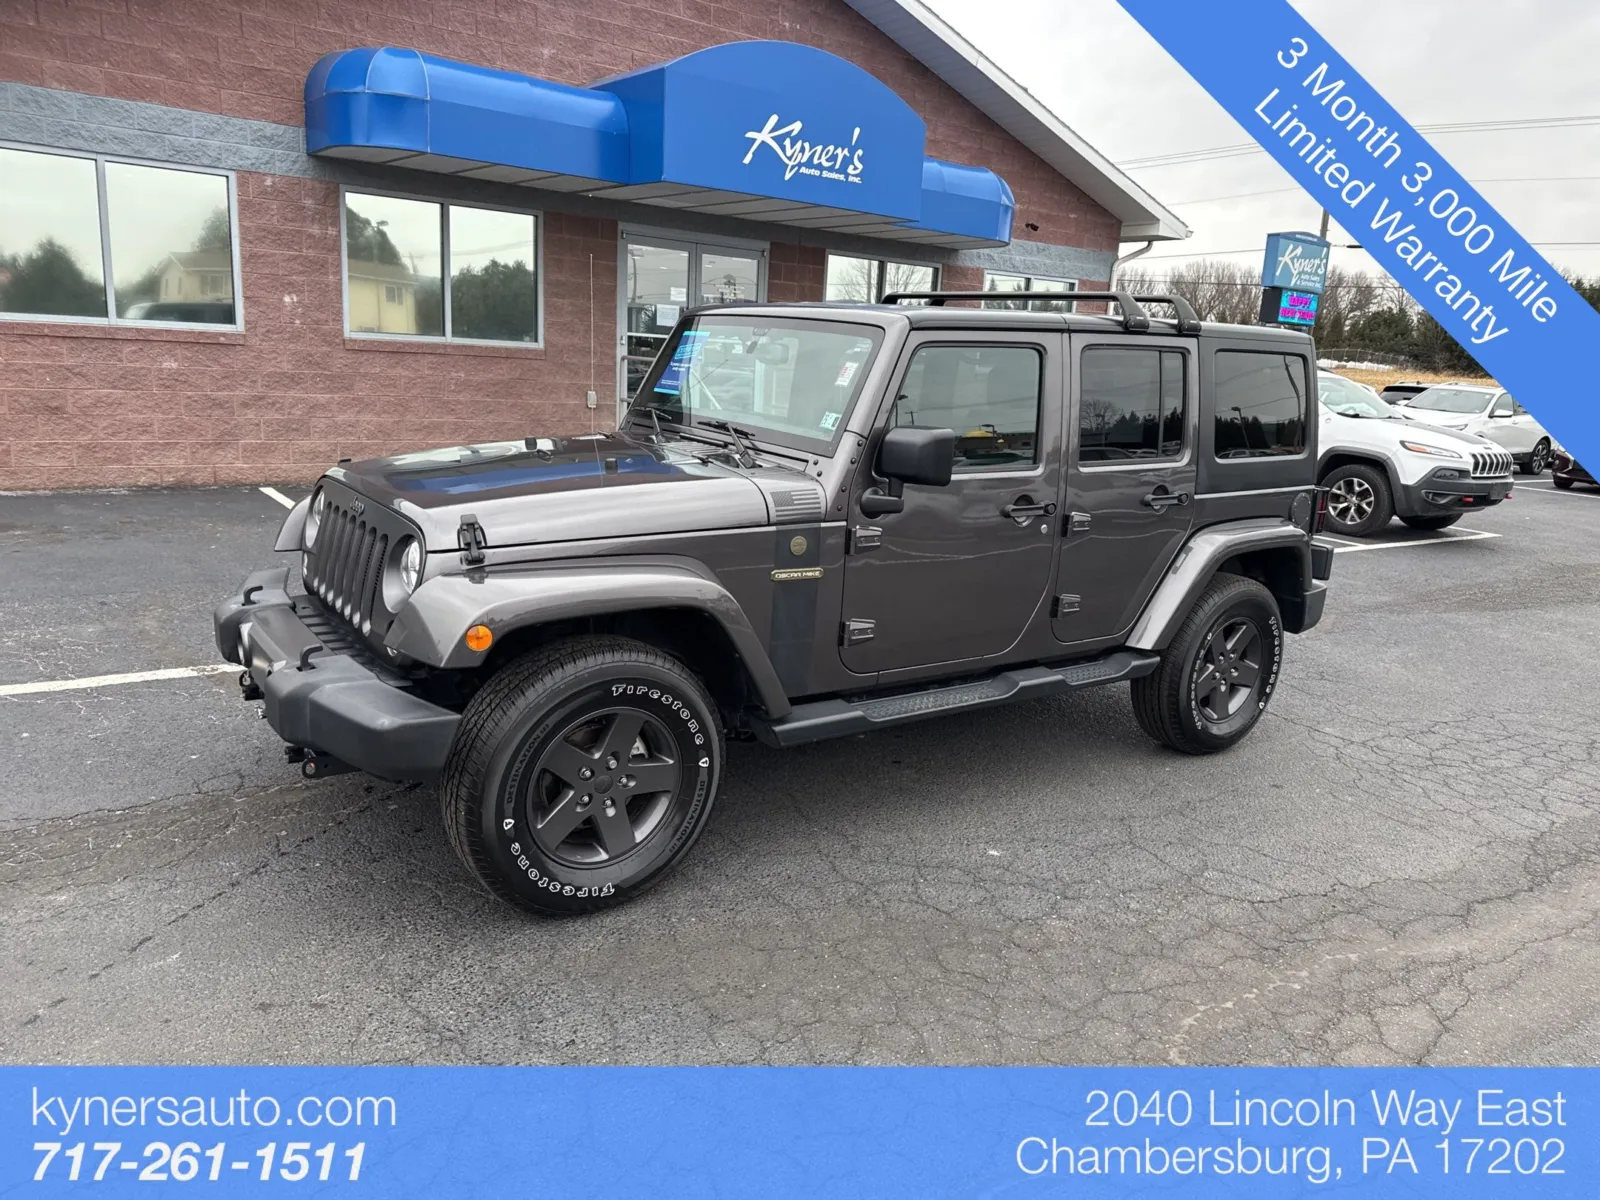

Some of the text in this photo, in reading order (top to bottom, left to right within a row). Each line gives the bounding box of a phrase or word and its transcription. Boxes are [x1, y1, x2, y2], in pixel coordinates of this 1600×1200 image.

[742, 113, 864, 181] Kyner's
[799, 166, 821, 177] Auto
[821, 169, 846, 182] Sales,
[1275, 243, 1327, 287] Kyner's
[1279, 307, 1295, 318] NEW
[1289, 296, 1311, 307] HAPPY
[611, 683, 705, 745] Firestone
[507, 734, 541, 804] DESTINATION
[676, 780, 706, 843] DESTINATION
[510, 842, 615, 898] Firestone
